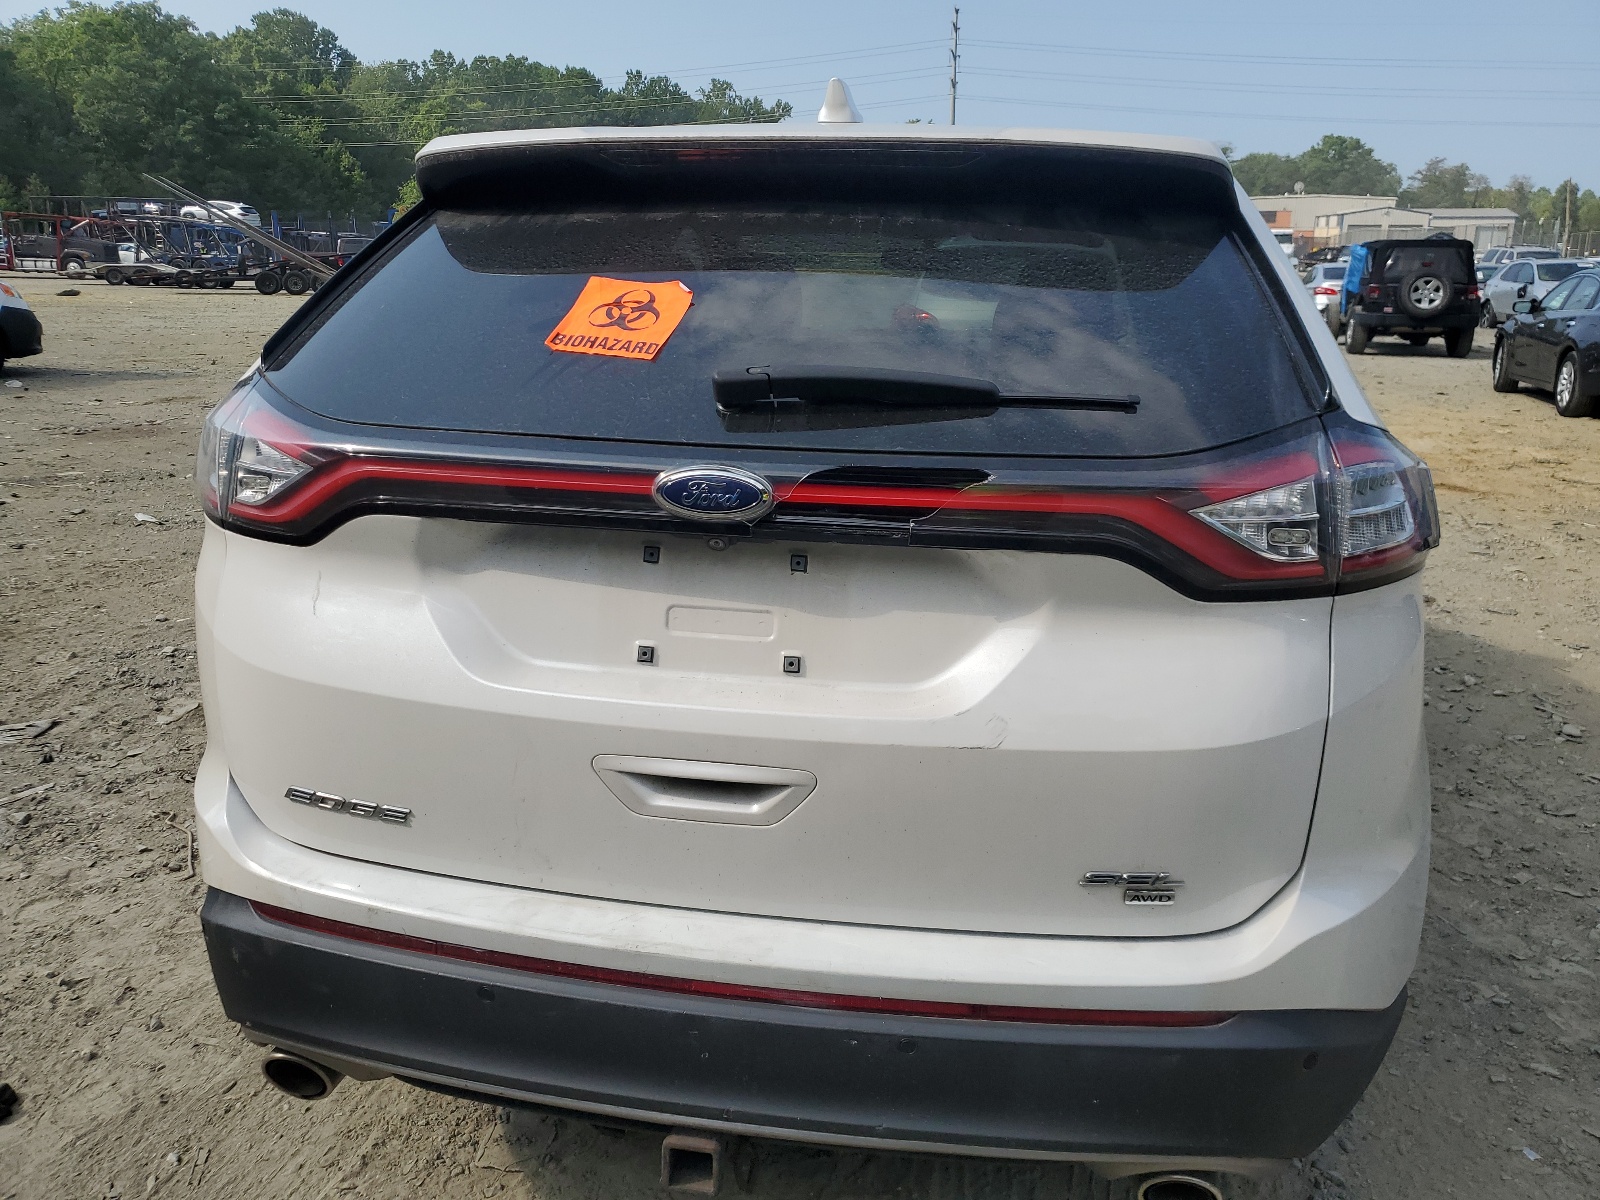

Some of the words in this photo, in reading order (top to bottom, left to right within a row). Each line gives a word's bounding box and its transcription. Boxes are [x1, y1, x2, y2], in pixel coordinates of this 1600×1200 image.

[550, 332, 659, 355] BIOHAZARD
[681, 480, 742, 507] Ford
[284, 785, 412, 822] EDGE
[1079, 871, 1185, 887] SEL
[1129, 894, 1172, 903] AWD
